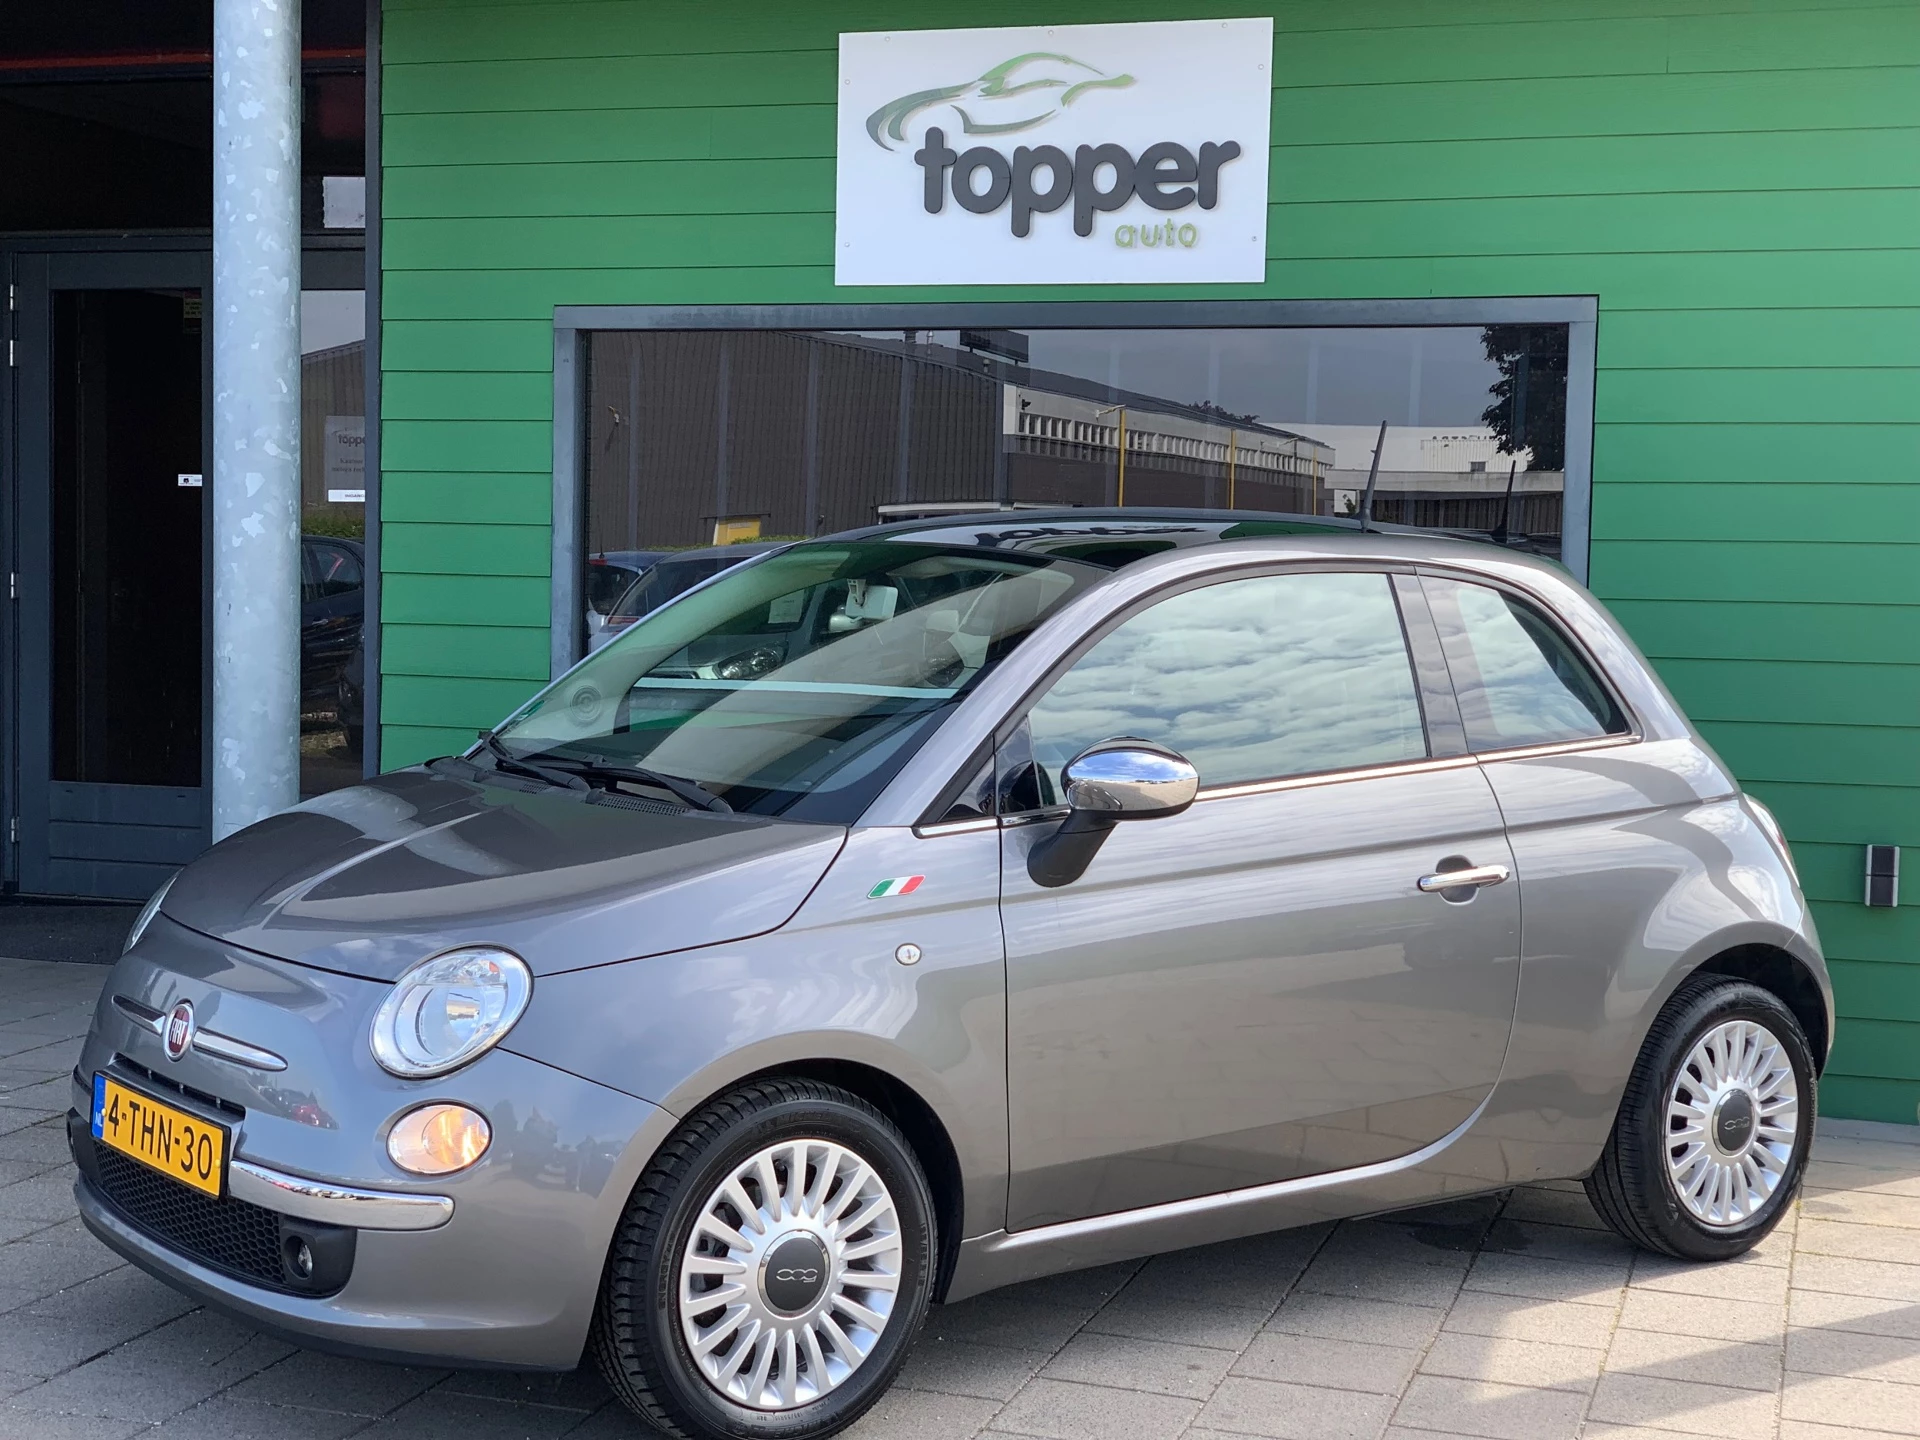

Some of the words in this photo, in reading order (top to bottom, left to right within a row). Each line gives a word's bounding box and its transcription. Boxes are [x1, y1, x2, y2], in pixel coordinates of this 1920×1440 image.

[914, 126, 1241, 238] topper
[1114, 218, 1198, 248] auto
[95, 1112, 103, 1128] NL
[108, 1093, 213, 1180] 4-THN-30
